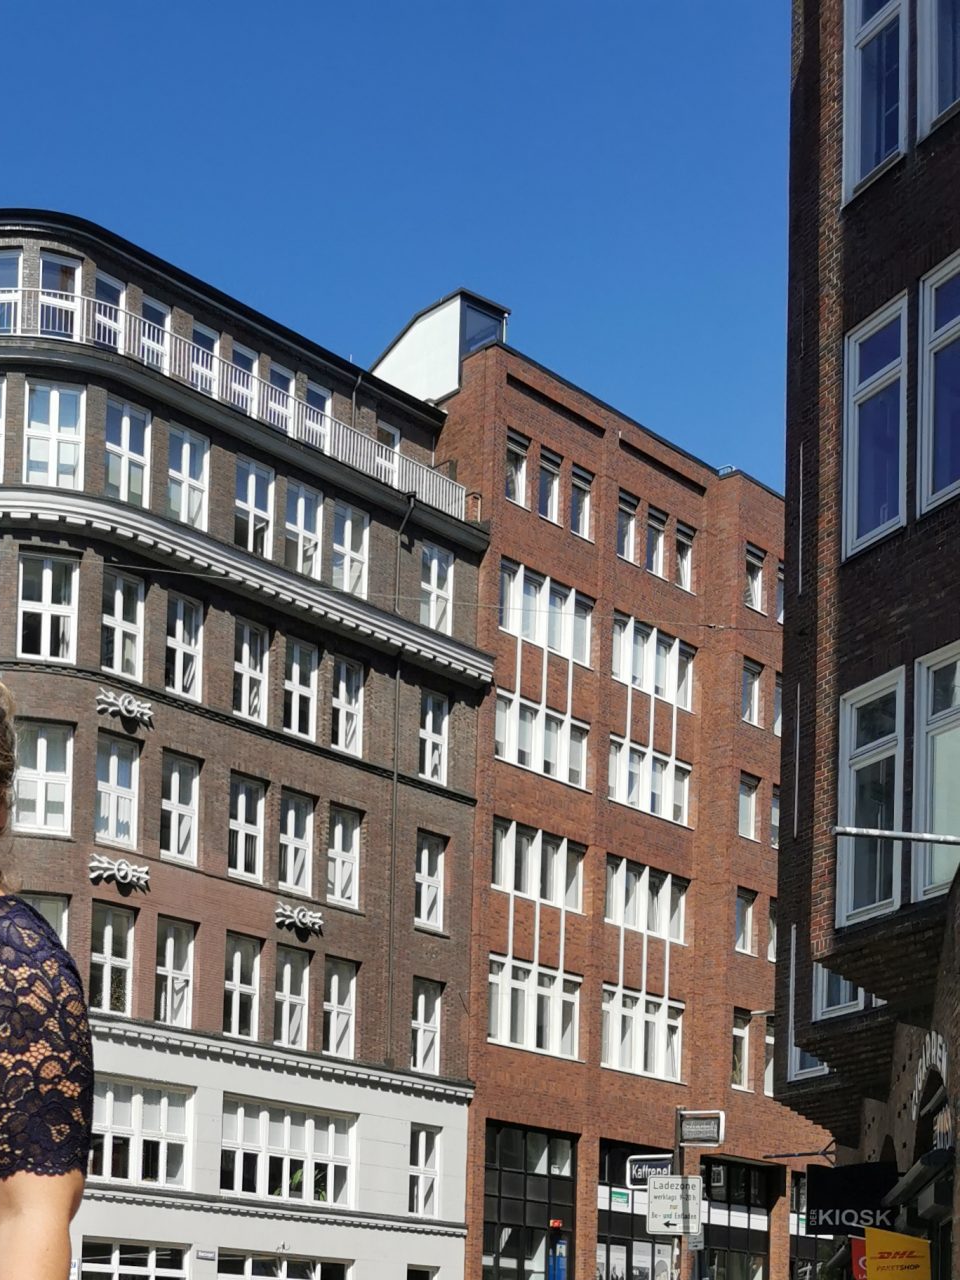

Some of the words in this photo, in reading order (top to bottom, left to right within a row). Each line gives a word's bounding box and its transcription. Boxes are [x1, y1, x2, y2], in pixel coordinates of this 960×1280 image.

[653, 1181, 696, 1191] Ladezone
[818, 1209, 892, 1226] KIOSK
[877, 1250, 917, 1260] DHL
